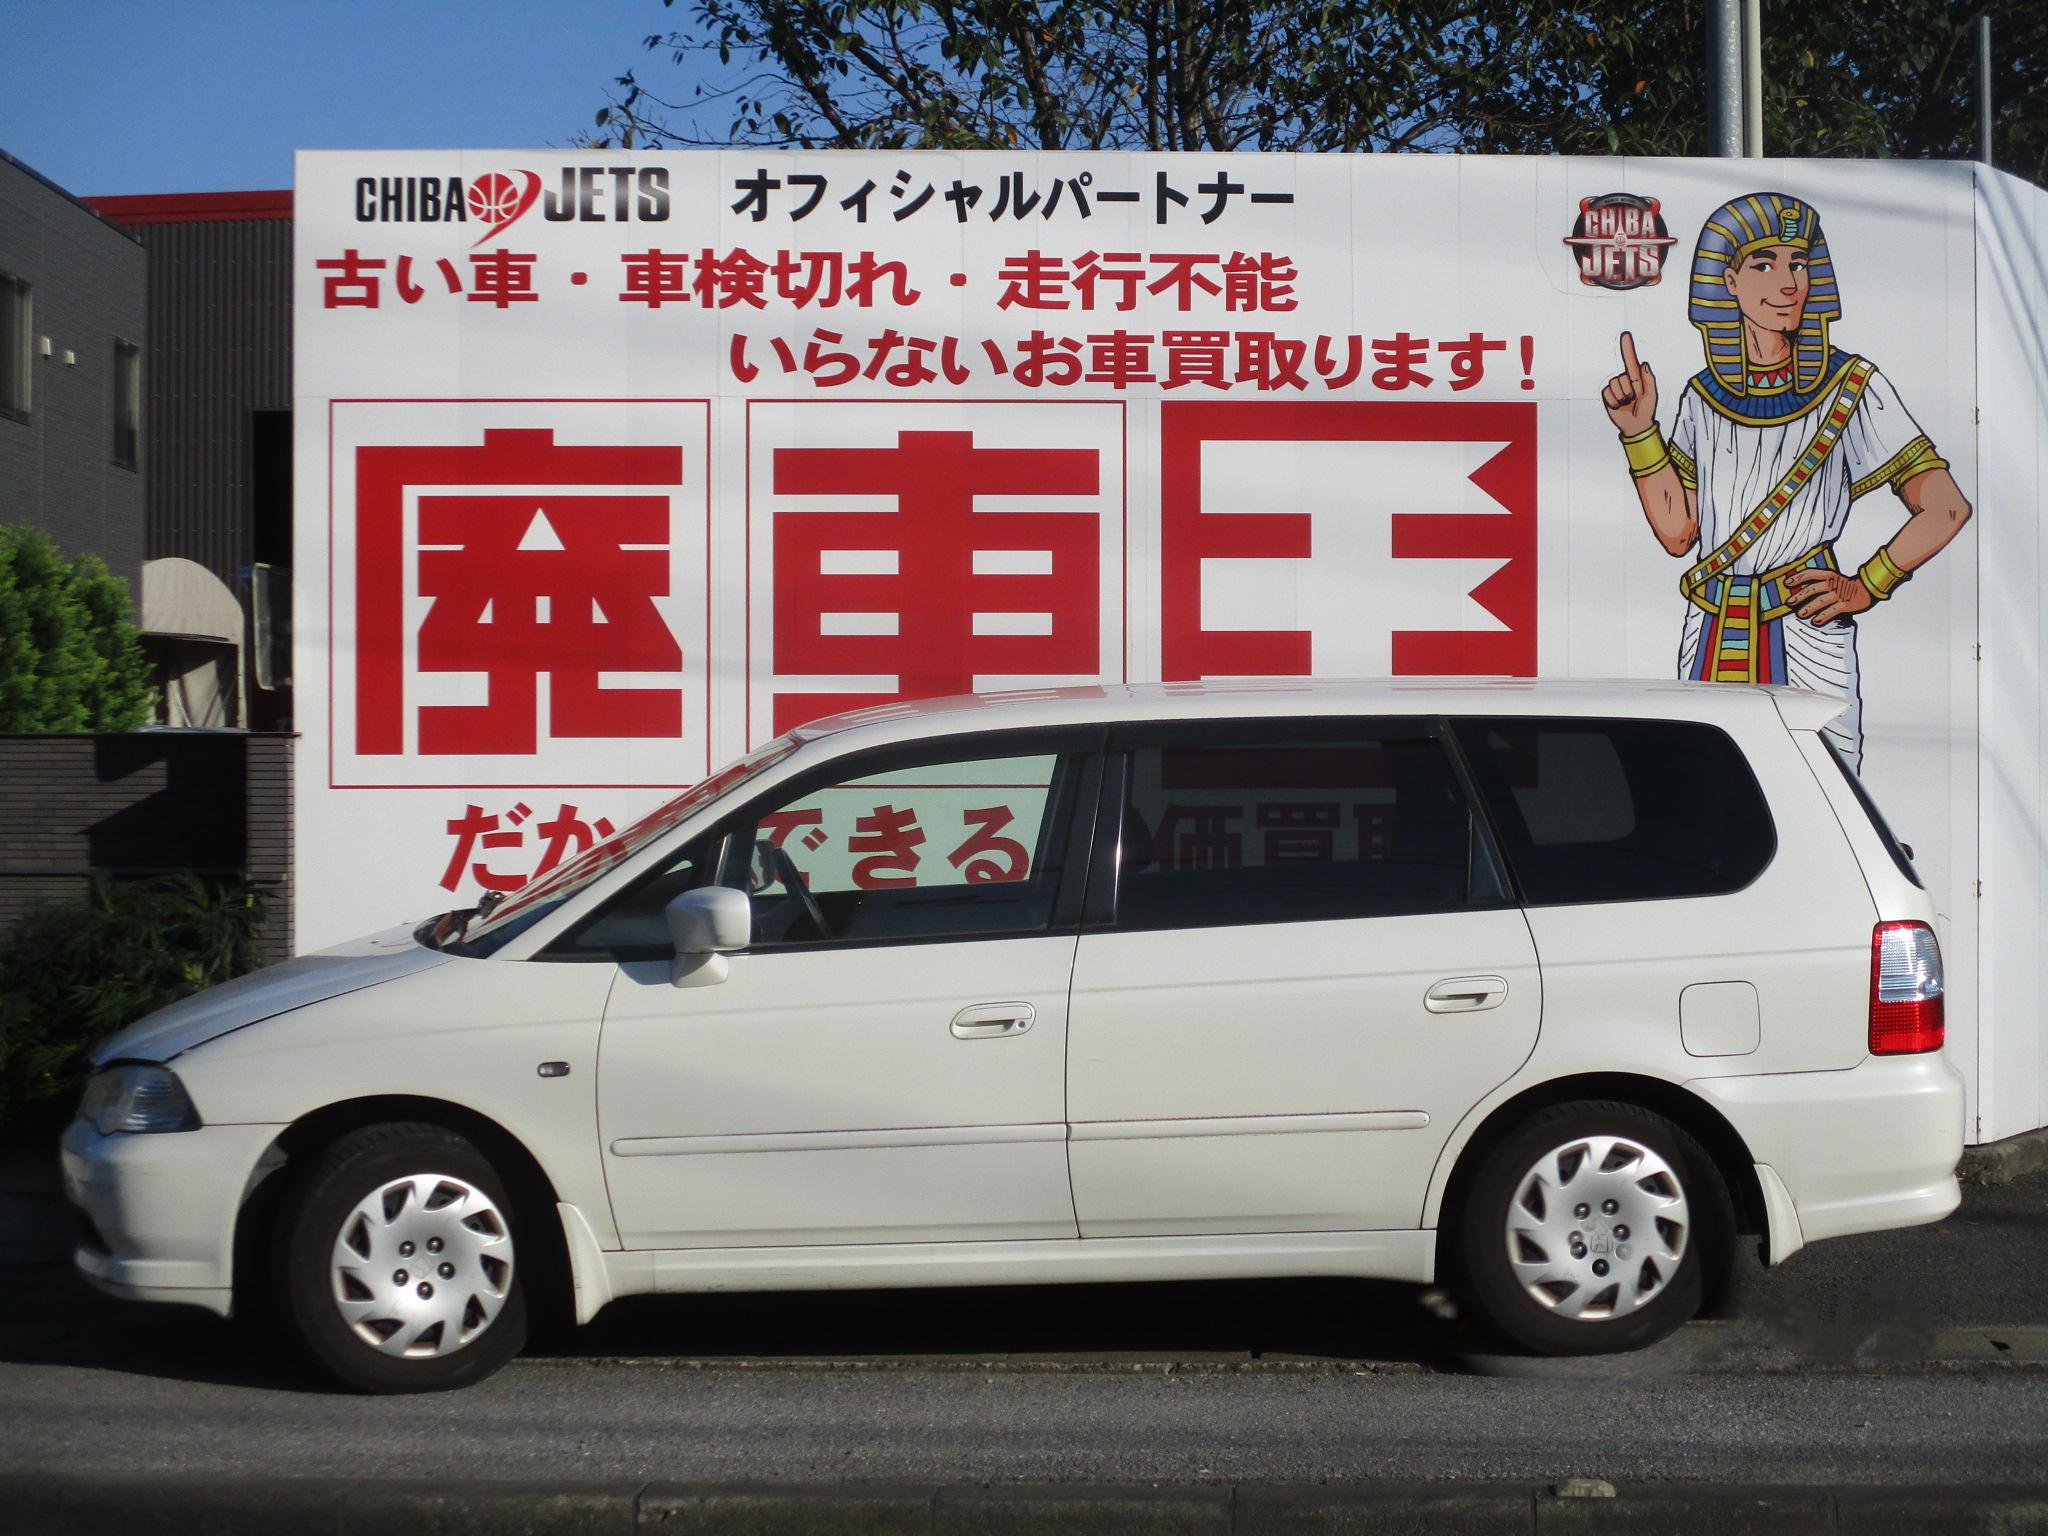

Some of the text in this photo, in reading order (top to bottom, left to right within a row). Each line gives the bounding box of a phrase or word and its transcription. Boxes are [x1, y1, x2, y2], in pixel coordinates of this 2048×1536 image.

[356, 166, 670, 223] CHIBA JETS
[731, 168, 1295, 225] オフィシャルパートナー
[1585, 208, 1656, 237] CHIBA
[316, 247, 1298, 312] 古い車・車検切れ・走行不能
[1582, 245, 1659, 280] JETS
